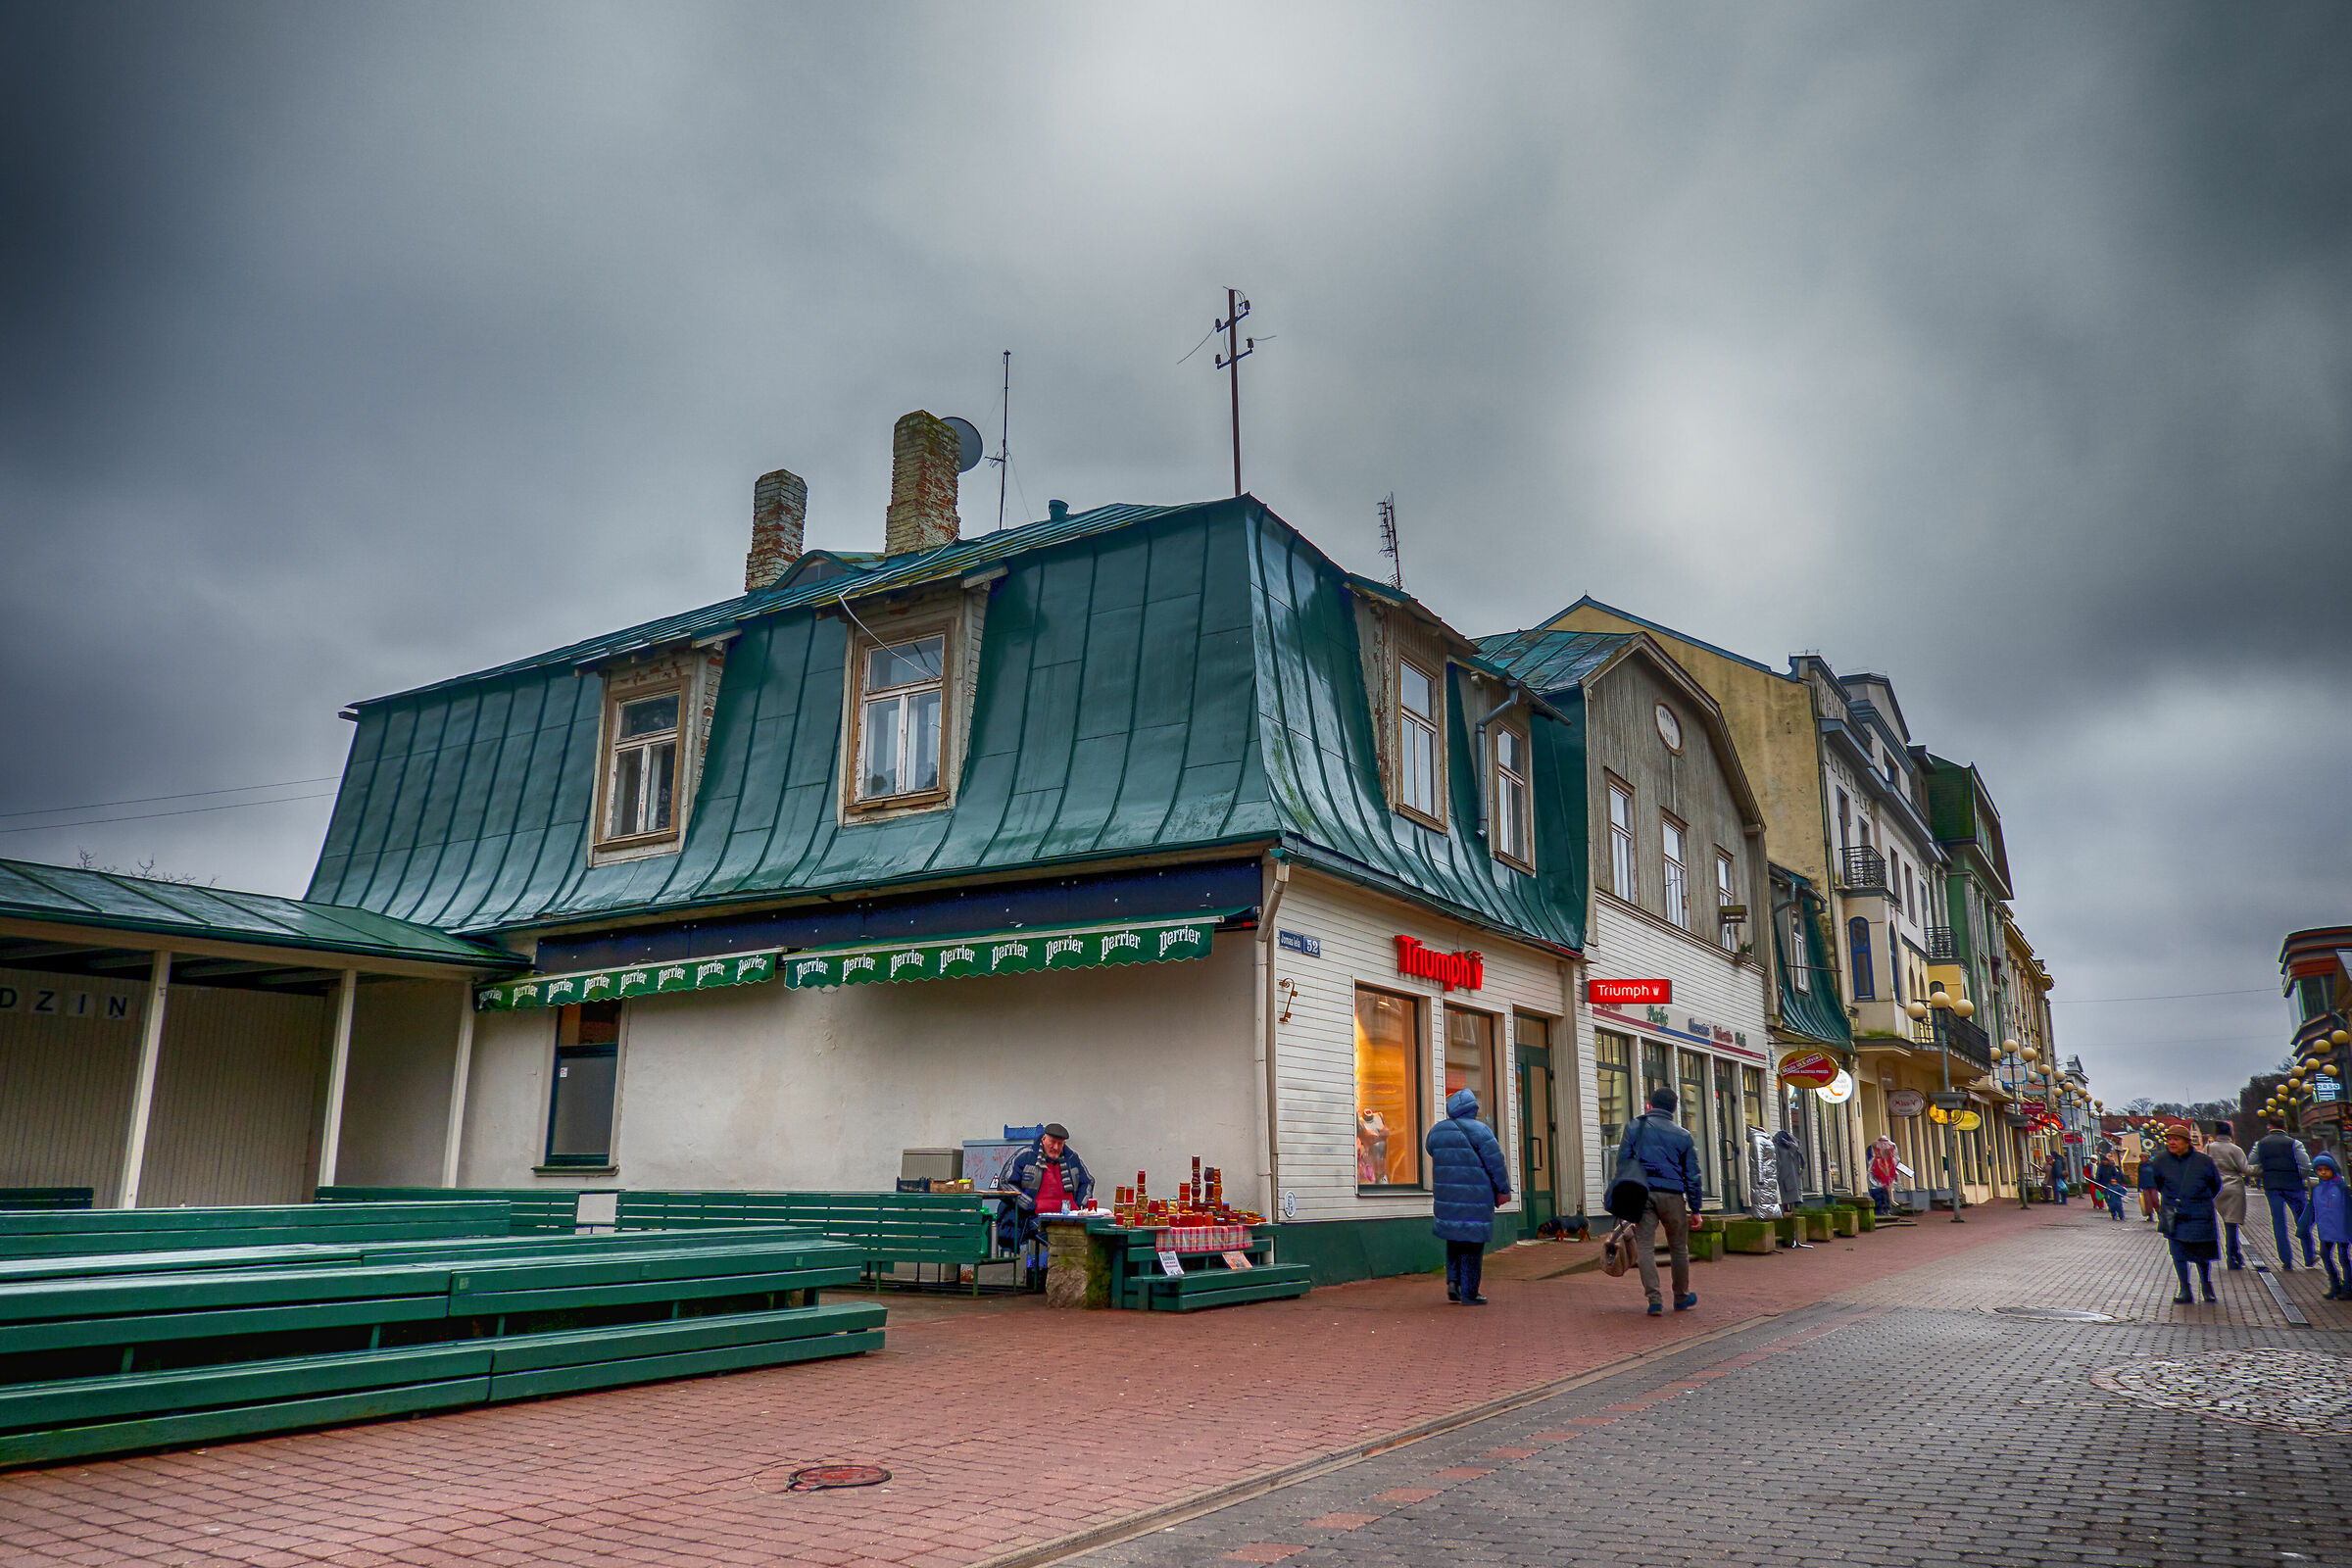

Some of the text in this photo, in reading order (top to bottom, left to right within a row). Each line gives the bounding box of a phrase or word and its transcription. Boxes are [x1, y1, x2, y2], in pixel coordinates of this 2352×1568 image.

[1306, 939, 1319, 954] 52
[1395, 935, 1471, 992] Triumph
[1597, 984, 1649, 1000] Triumph
